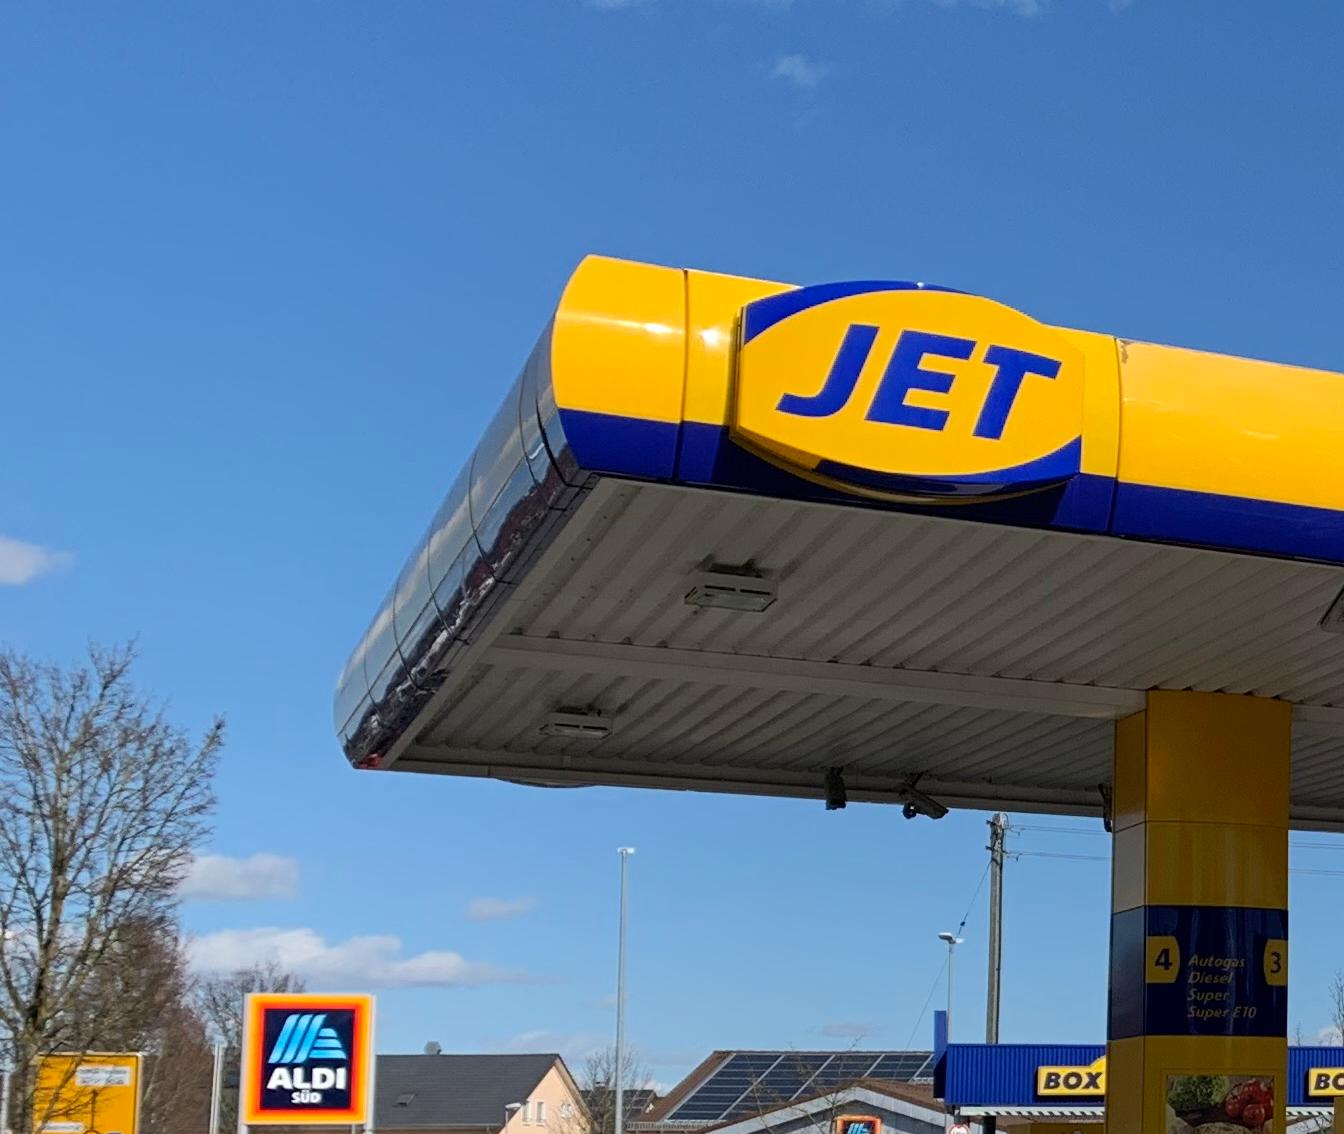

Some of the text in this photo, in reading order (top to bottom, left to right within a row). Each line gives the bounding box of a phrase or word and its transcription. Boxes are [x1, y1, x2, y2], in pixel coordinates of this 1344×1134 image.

[776, 323, 1062, 440] JET
[1155, 948, 1173, 971] 4
[1187, 953, 1245, 971] Autogas
[1269, 951, 1282, 974] 3
[1187, 971, 1233, 984] Diesel
[1187, 988, 1231, 1005] Super
[1187, 1005, 1257, 1022] Super E10
[266, 1066, 347, 1090] ALDI
[1043, 1071, 1103, 1090] BOX
[291, 1090, 322, 1104] SÜD
